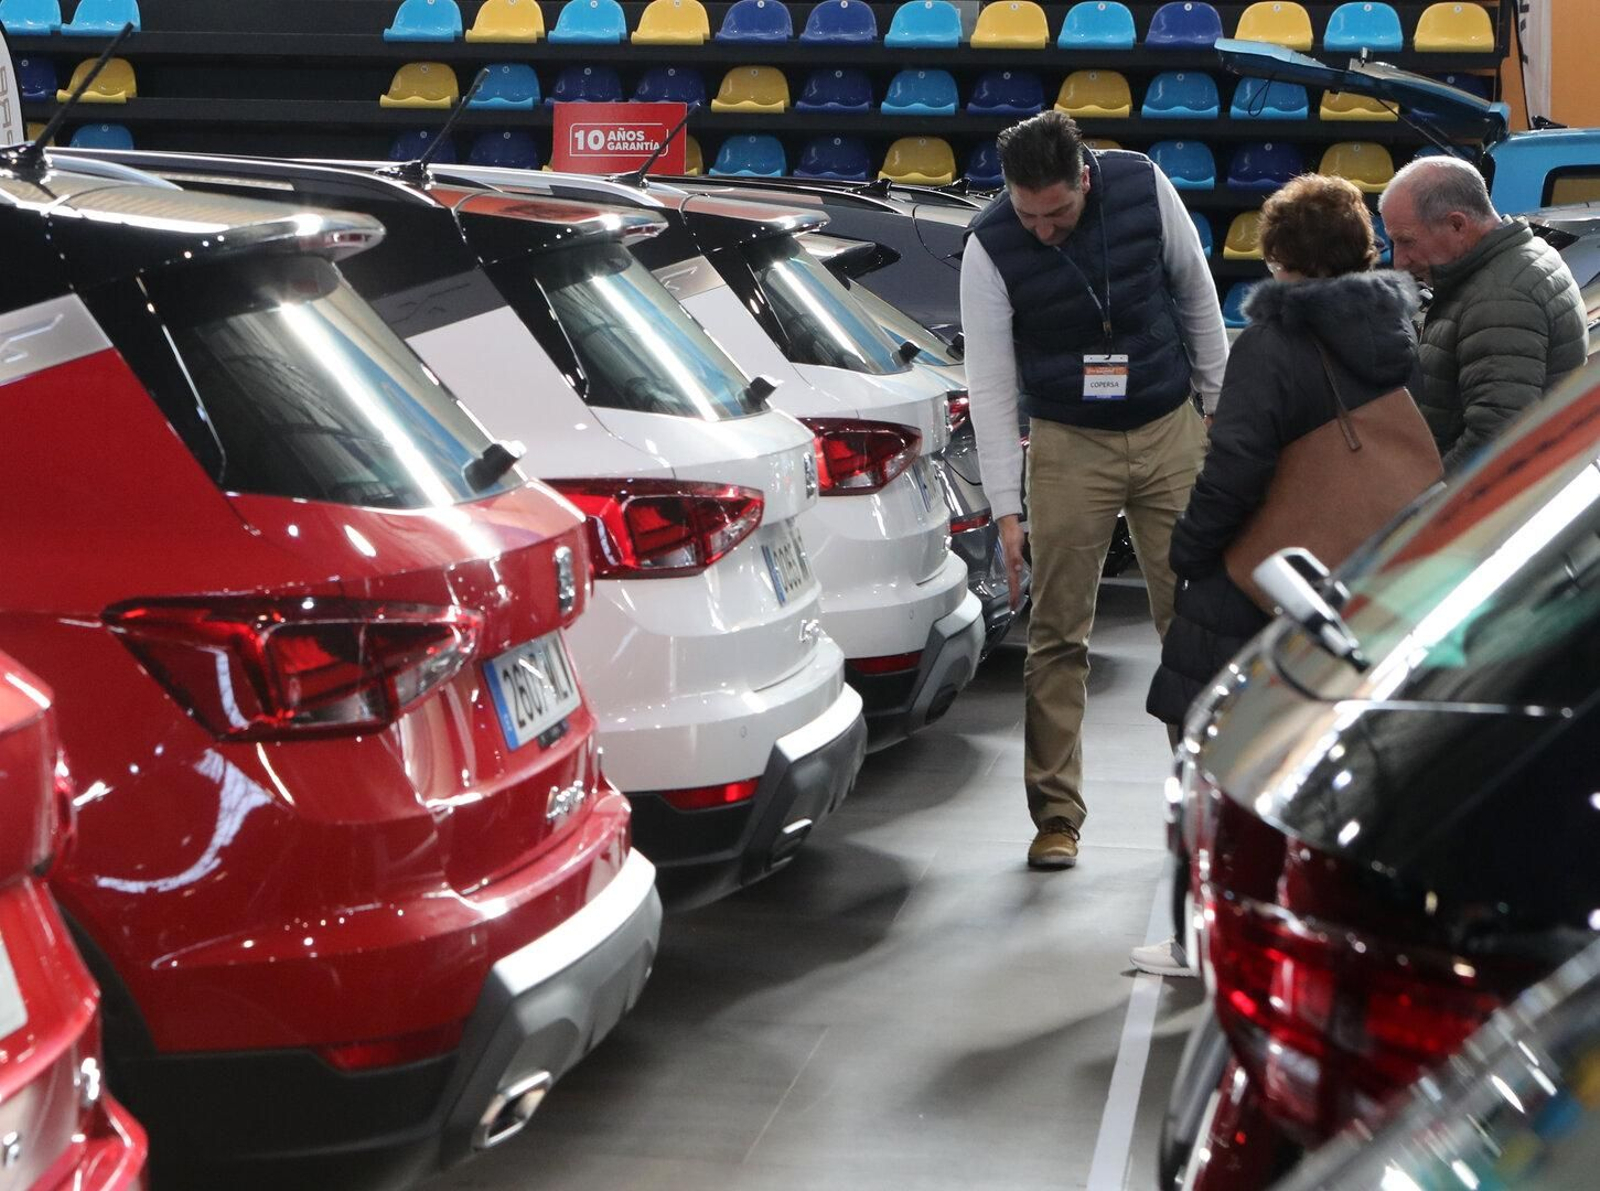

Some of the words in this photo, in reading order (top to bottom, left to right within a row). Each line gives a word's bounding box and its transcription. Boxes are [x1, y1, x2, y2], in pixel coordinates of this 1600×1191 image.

[575, 130, 605, 151] 10
[607, 127, 645, 141] AÑOS
[607, 139, 660, 151] GARANTÍA
